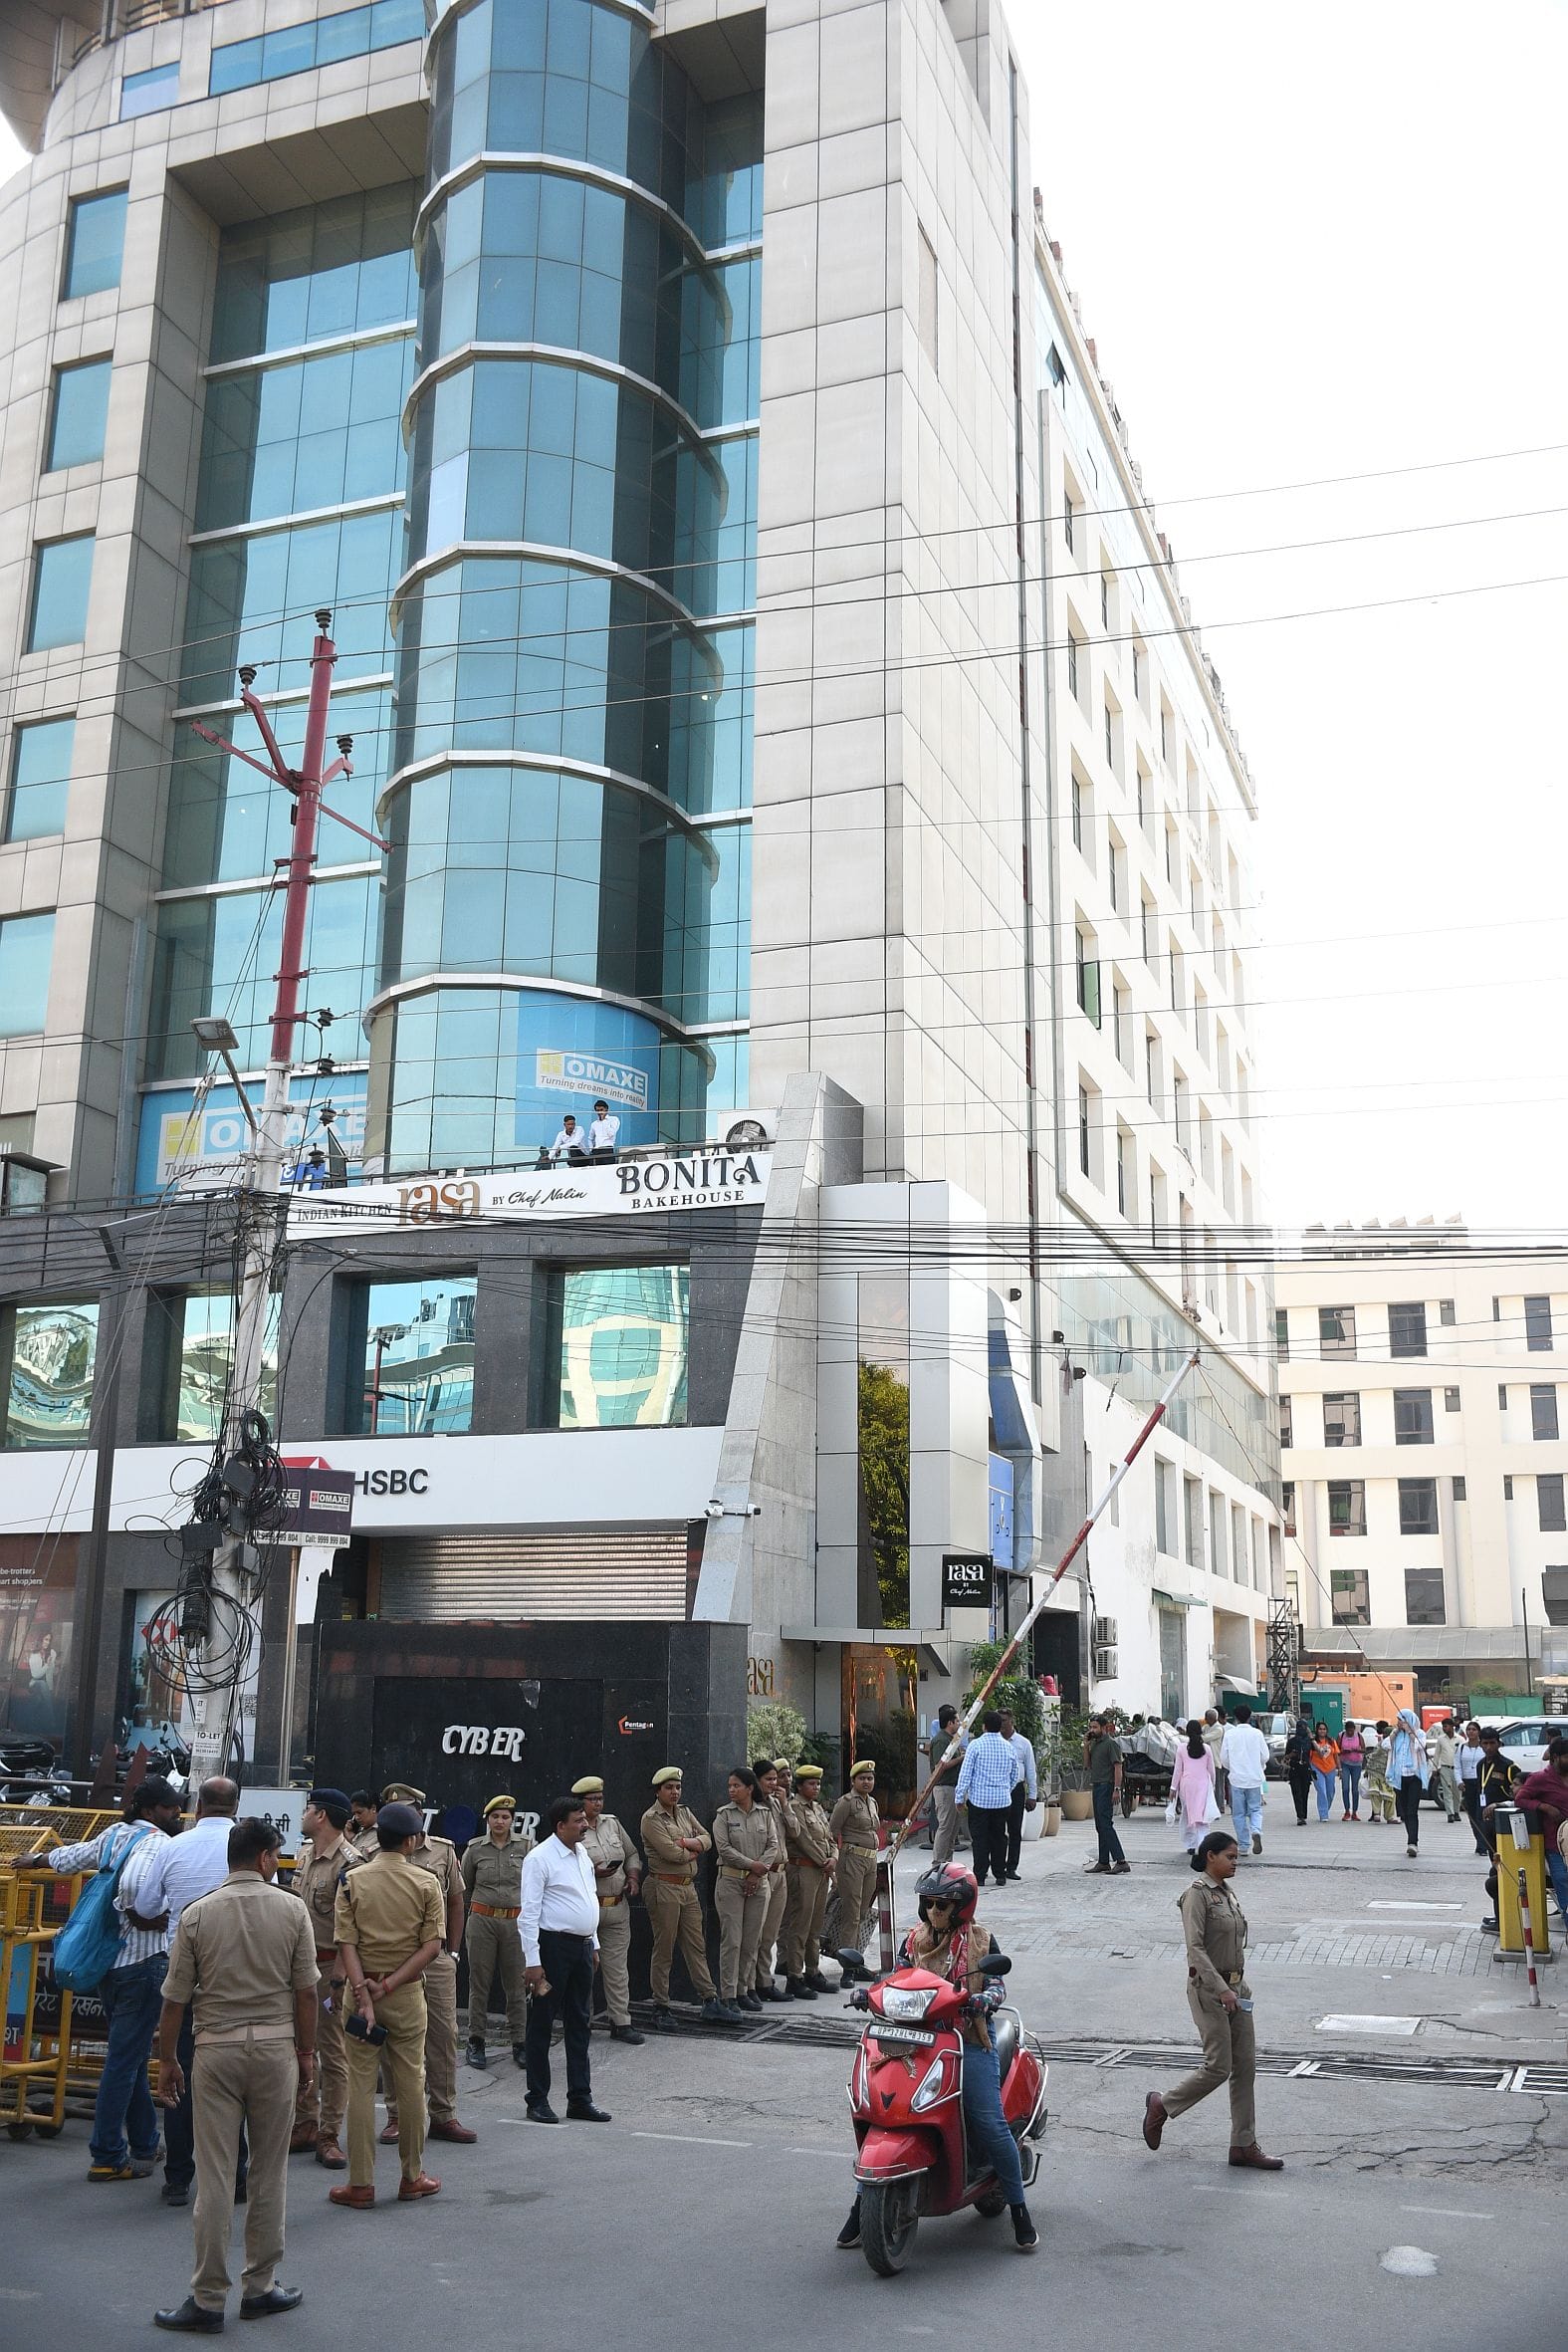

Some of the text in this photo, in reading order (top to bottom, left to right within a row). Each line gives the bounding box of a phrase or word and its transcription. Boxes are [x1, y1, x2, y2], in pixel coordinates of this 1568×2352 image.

[566, 1059, 645, 1093] OMAXE
[541, 1075, 645, 1108] Turning dreams into reality
[209, 1106, 366, 1148] OAXE
[616, 1155, 762, 1195] BONITA
[397, 1180, 481, 1226] rasa
[492, 1187, 587, 1207] BY Chef Nalin
[632, 1190, 745, 1209] BAKEHOUSE
[298, 1208, 338, 1222] INDIAN
[354, 1468, 429, 1496] HSBC
[320, 1494, 348, 1505] OMAXE
[305, 1534, 317, 1543] Call:
[947, 1563, 987, 1581] rasa
[748, 1656, 776, 1697] asa
[442, 1725, 526, 1763] CYBER
